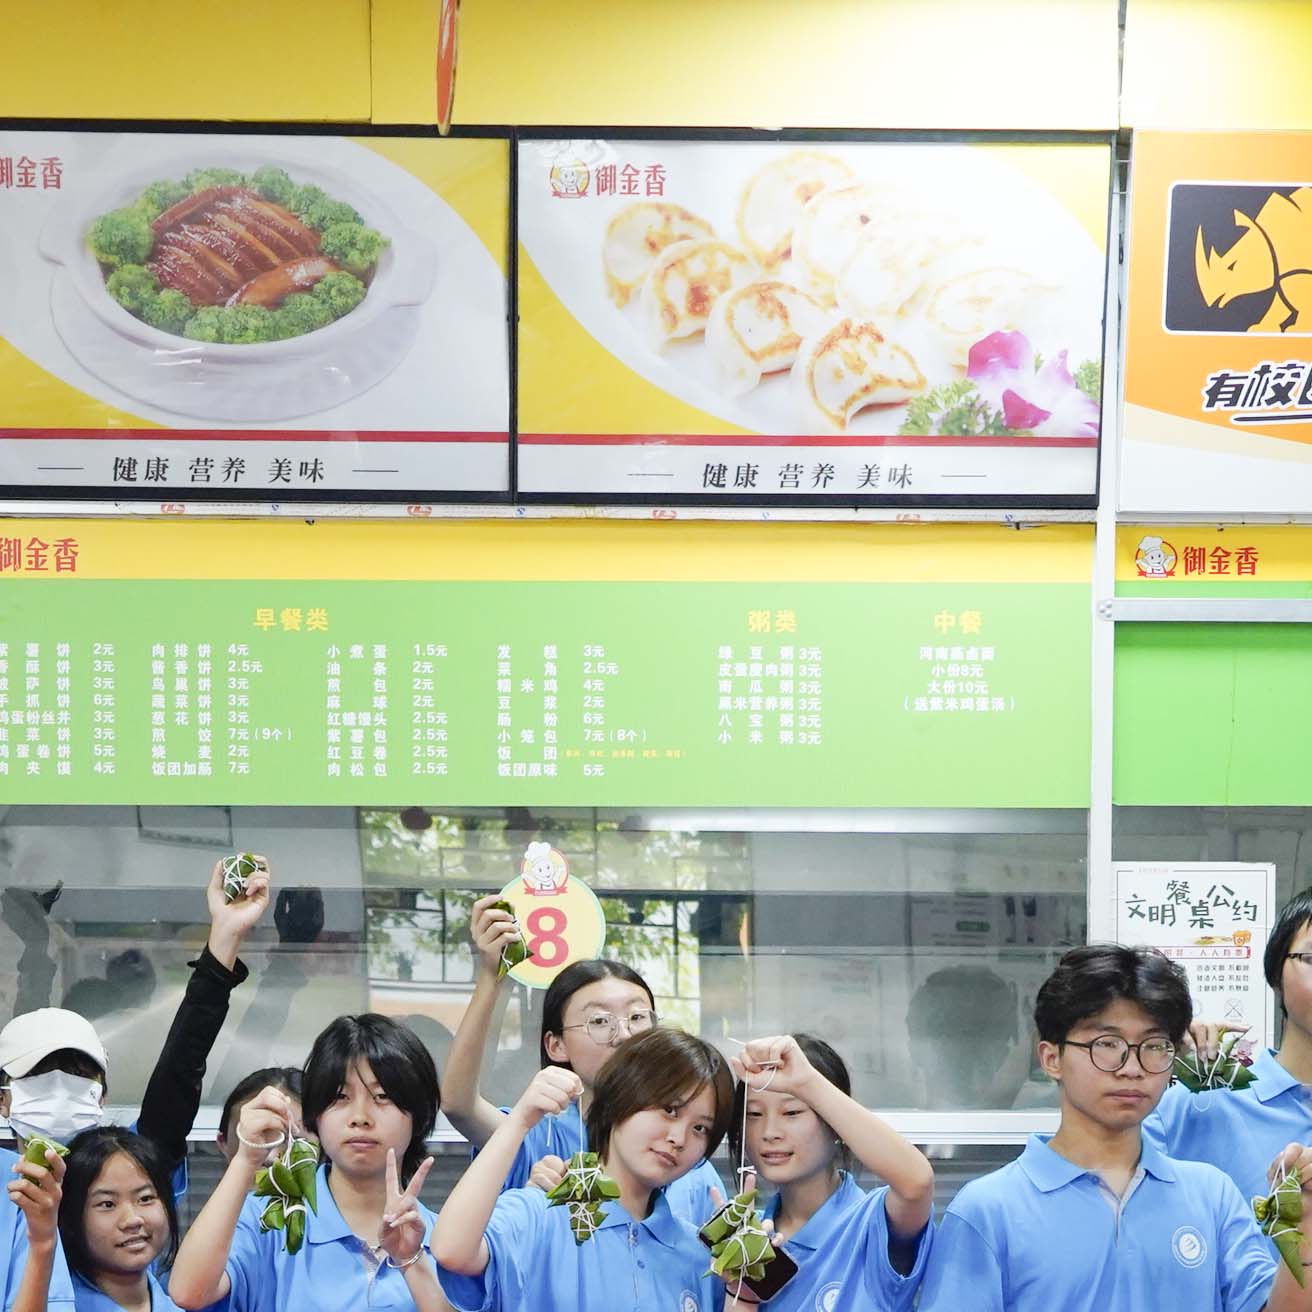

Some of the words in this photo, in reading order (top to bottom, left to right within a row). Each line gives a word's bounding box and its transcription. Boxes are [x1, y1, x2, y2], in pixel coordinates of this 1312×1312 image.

[597, 164, 664, 196] 御金香
[113, 457, 168, 482] 健康
[189, 458, 245, 482] 营养
[270, 458, 323, 483] 美味
[703, 464, 759, 488] 健康
[779, 464, 834, 488] 营养
[858, 464, 912, 488] 美味
[1183, 546, 1259, 575] 御金香
[254, 607, 328, 632] 早餐类
[94, 643, 114, 655] 2元
[228, 644, 248, 656] 4元
[414, 644, 447, 656] 1.5元
[584, 645, 604, 657] 3元
[799, 648, 821, 661] 3元
[94, 660, 114, 672] 3元
[228, 660, 263, 672] 2.5元
[413, 661, 434, 673] 2元
[799, 664, 822, 677] 3元
[93, 677, 114, 689] 3元
[228, 677, 248, 689] 3元
[413, 678, 433, 690] 2元
[584, 679, 604, 691] 4元
[799, 681, 821, 694] 3元
[94, 694, 114, 706] 6元
[228, 694, 248, 707] 3元
[413, 695, 434, 707] 2元
[584, 696, 604, 708] 2元
[799, 698, 821, 711] 3元
[94, 711, 114, 723] 3元
[228, 711, 249, 723] 3元
[413, 712, 448, 724] 2.5元
[584, 712, 604, 724] 6元
[799, 715, 821, 728] 3元
[94, 728, 115, 740] 3元
[413, 728, 448, 741] 2.5元
[799, 732, 821, 744] 3元
[93, 744, 115, 756] 5元
[228, 745, 249, 757] 2元
[413, 745, 448, 757] 2.5元
[94, 762, 115, 773] 4元
[229, 762, 249, 773] 7元
[413, 762, 448, 775] 2.5元
[584, 764, 604, 776] 5元
[527, 907, 568, 968] 8
